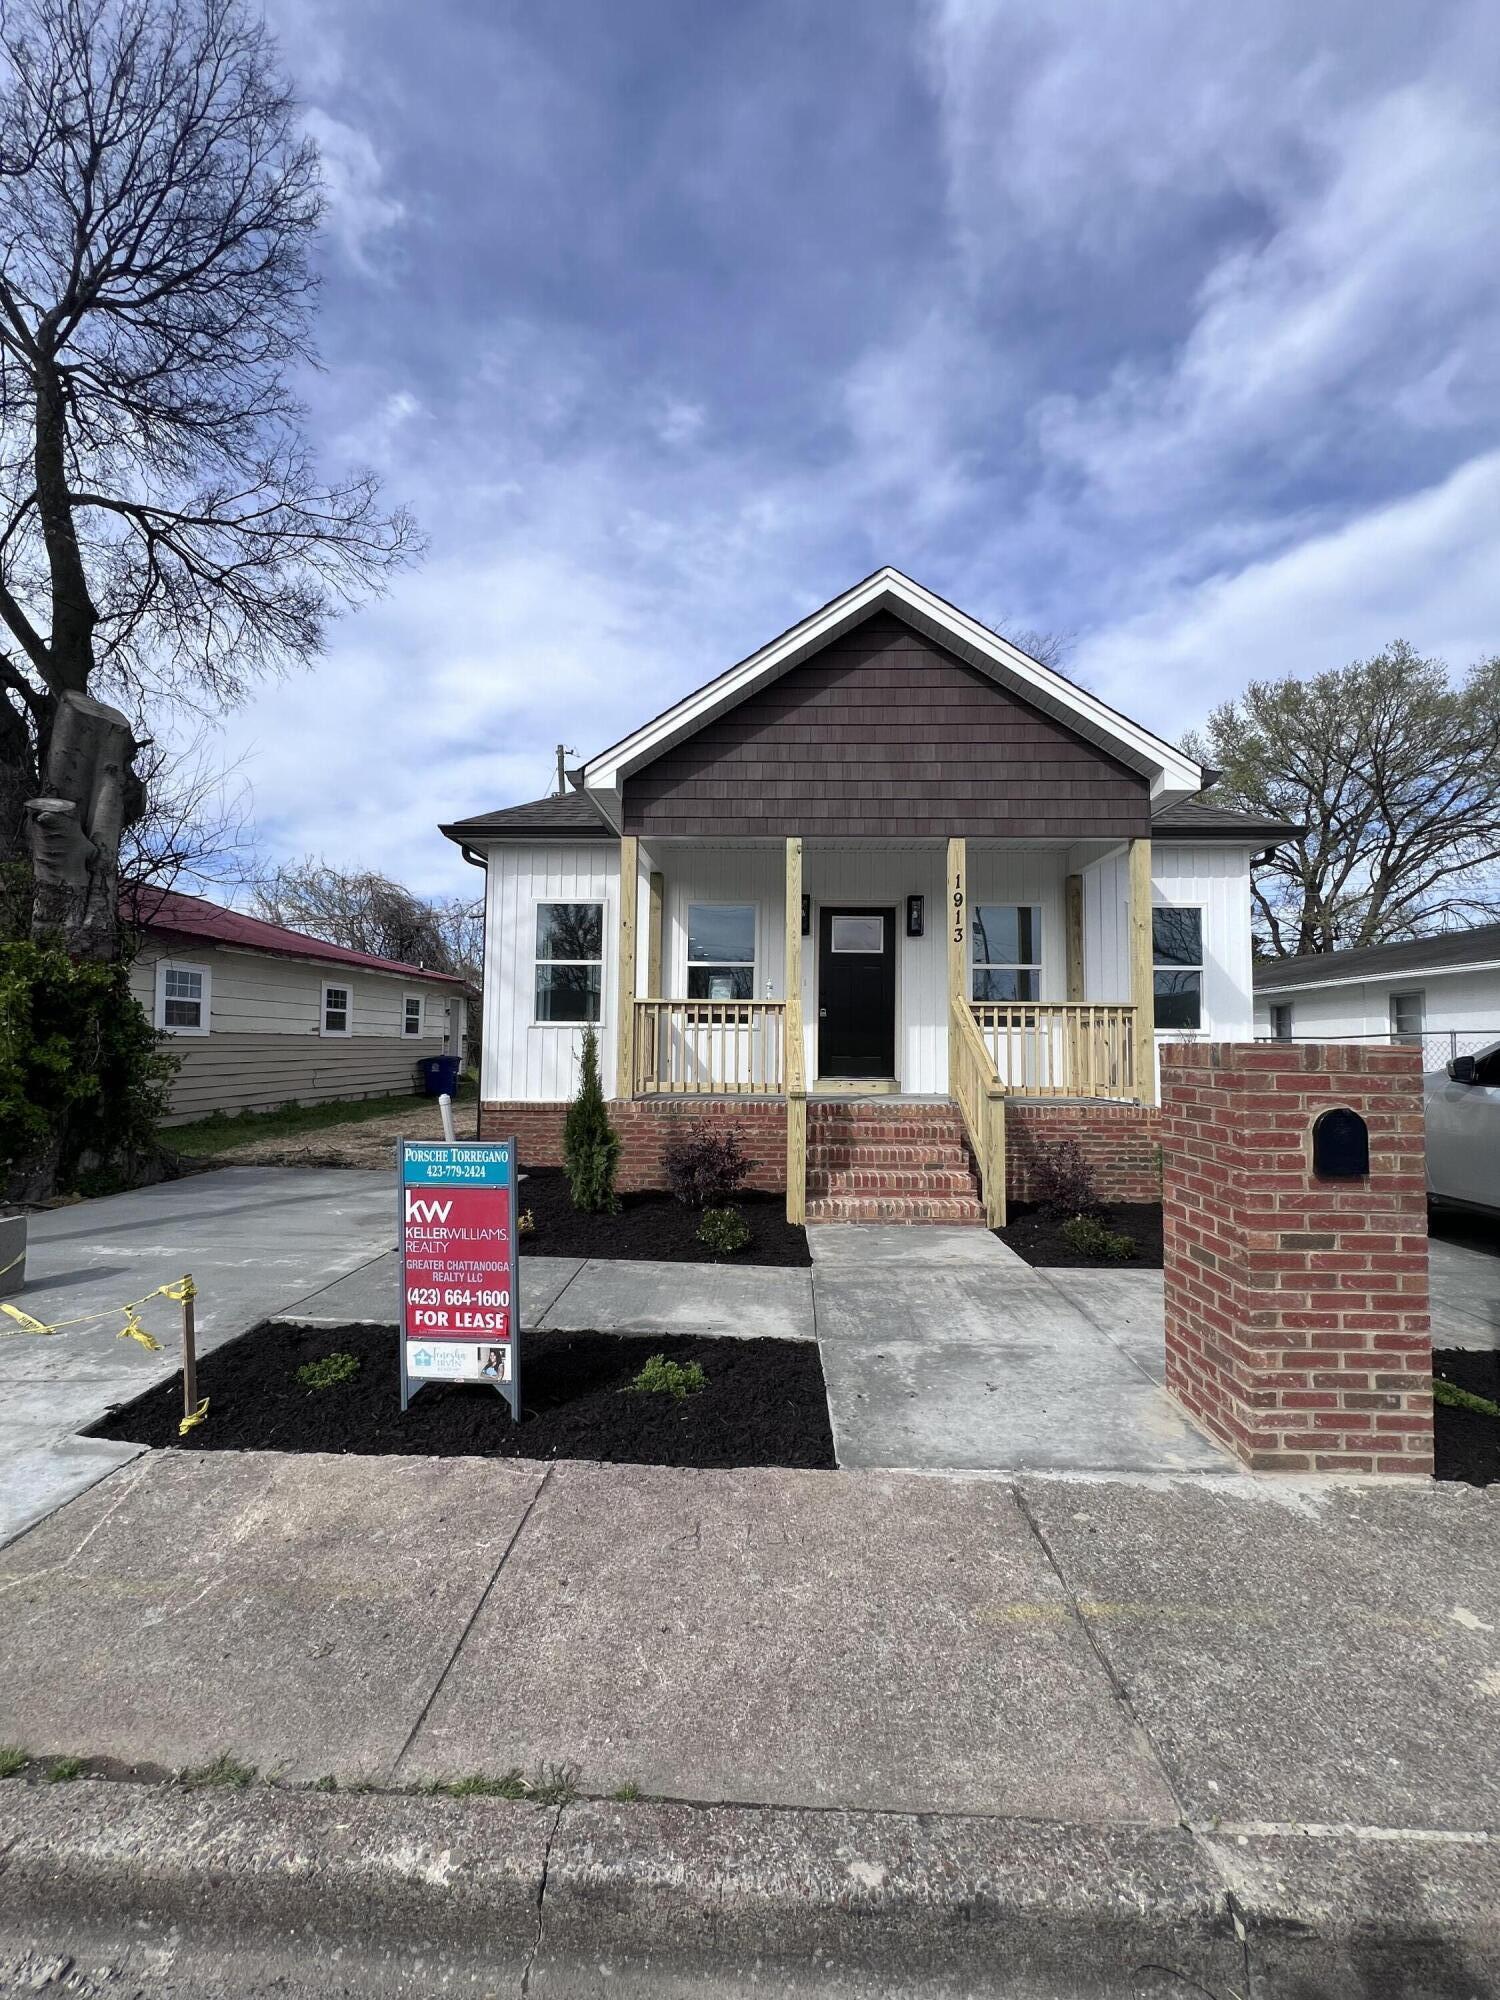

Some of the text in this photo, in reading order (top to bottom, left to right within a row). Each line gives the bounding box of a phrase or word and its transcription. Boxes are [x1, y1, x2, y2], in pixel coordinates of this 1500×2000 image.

[953, 874, 963, 942] 1913
[405, 1148, 508, 1163] PORSCHE TORREGANO
[427, 1165, 486, 1177] 423-779-2424
[405, 1189, 453, 1223] kw
[405, 1240, 450, 1253] REALTY
[406, 1259, 510, 1271] GREATER CHATTANOOGA
[432, 1272, 483, 1283] REALTY LLC
[407, 1287, 509, 1307] (423) 664-1600
[415, 1310, 504, 1329] FOR LEASE
